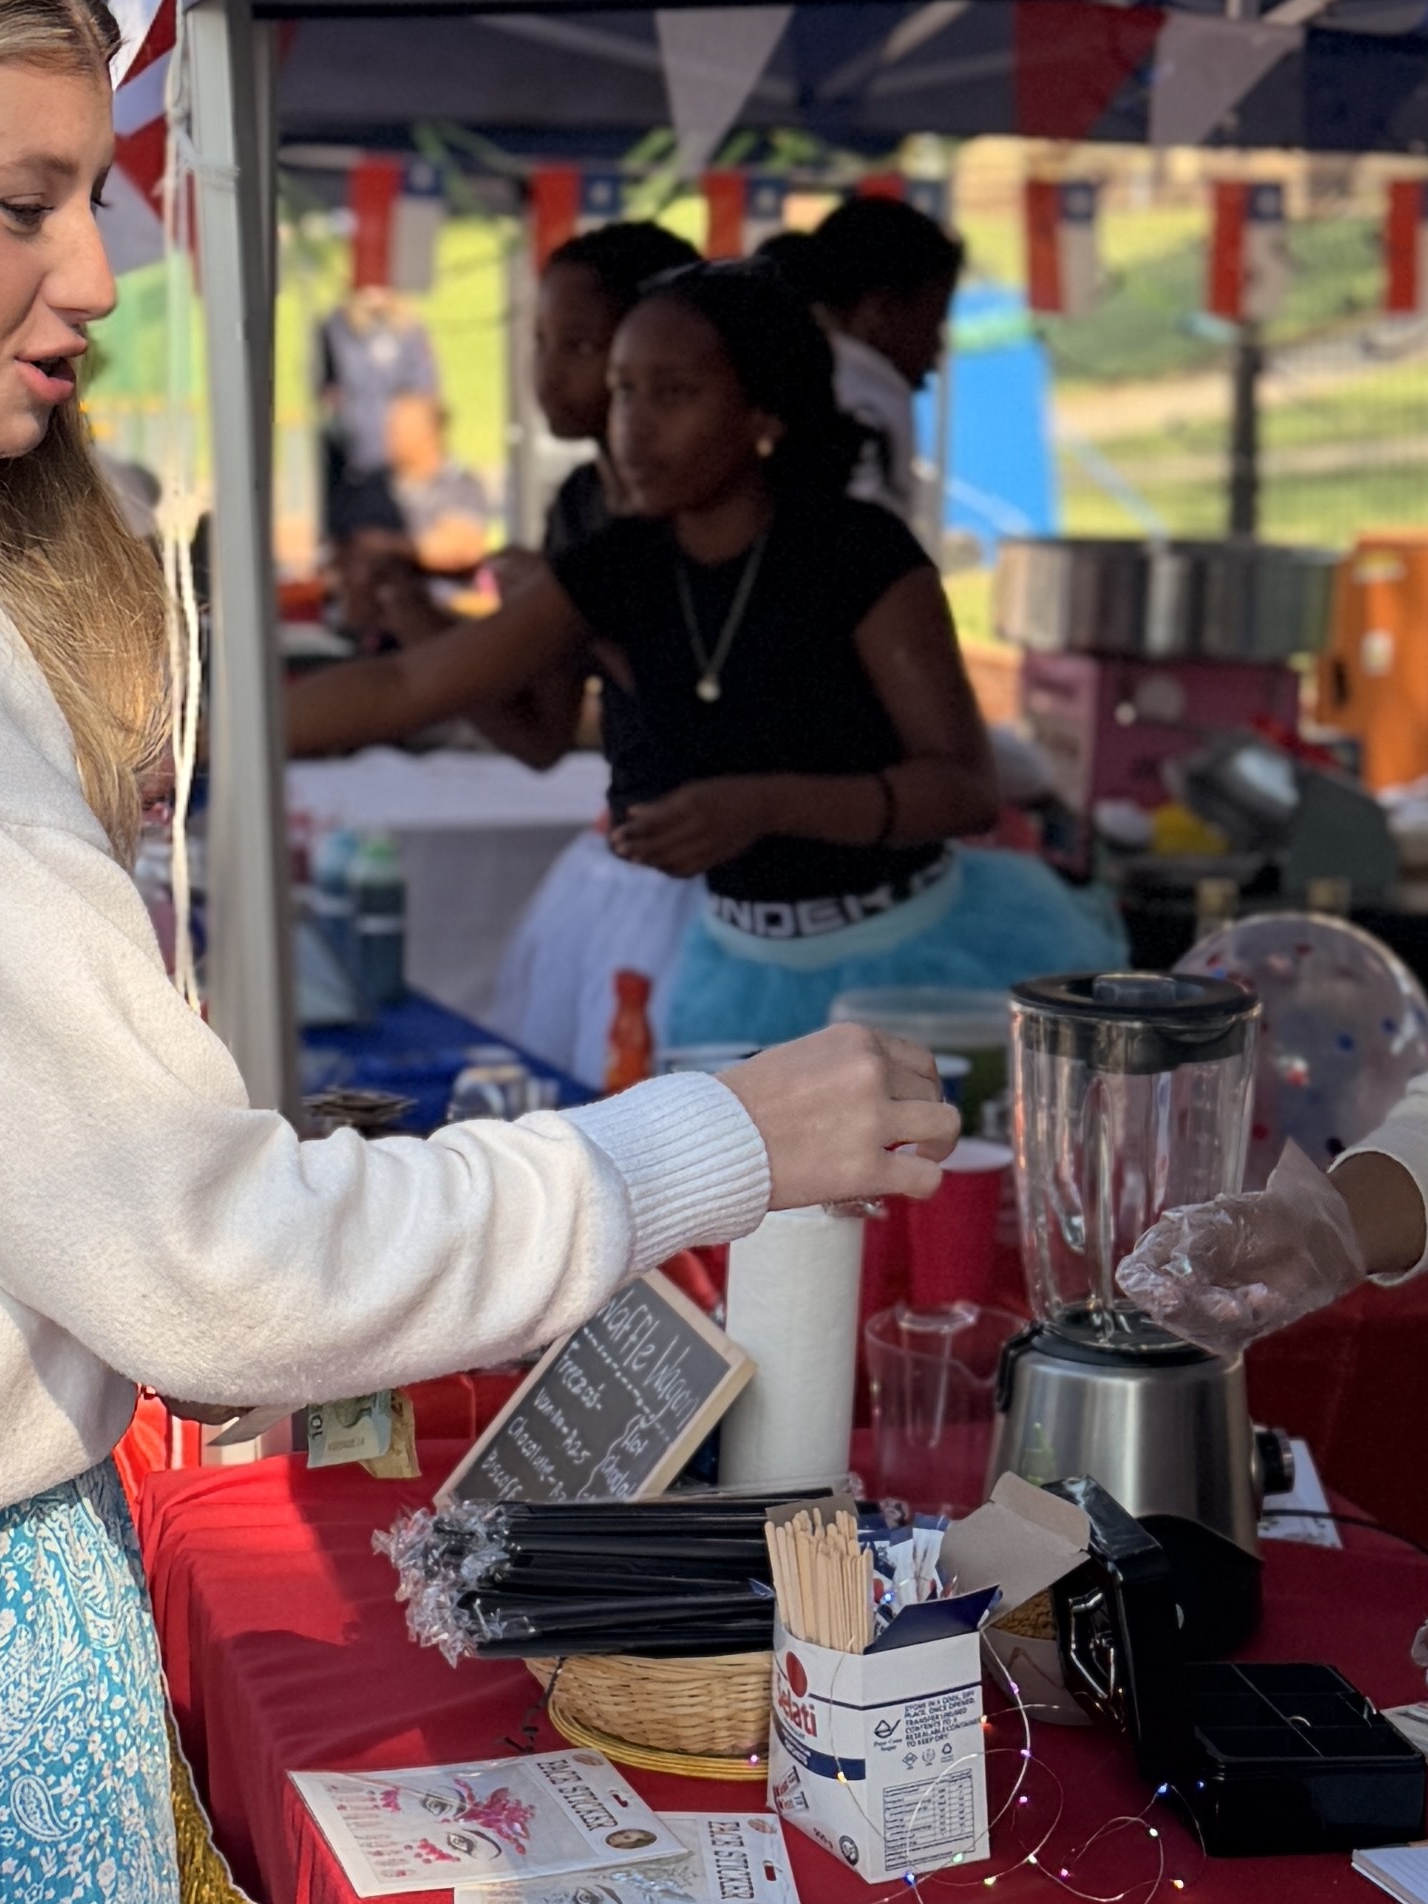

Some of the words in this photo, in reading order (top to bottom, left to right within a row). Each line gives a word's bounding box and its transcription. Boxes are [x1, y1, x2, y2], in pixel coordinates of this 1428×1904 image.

[536, 1759, 583, 1785] FACE
[557, 1785, 619, 1832] STICKER
[707, 1821, 745, 1847] FACE
[713, 1850, 755, 1900] STICKER
